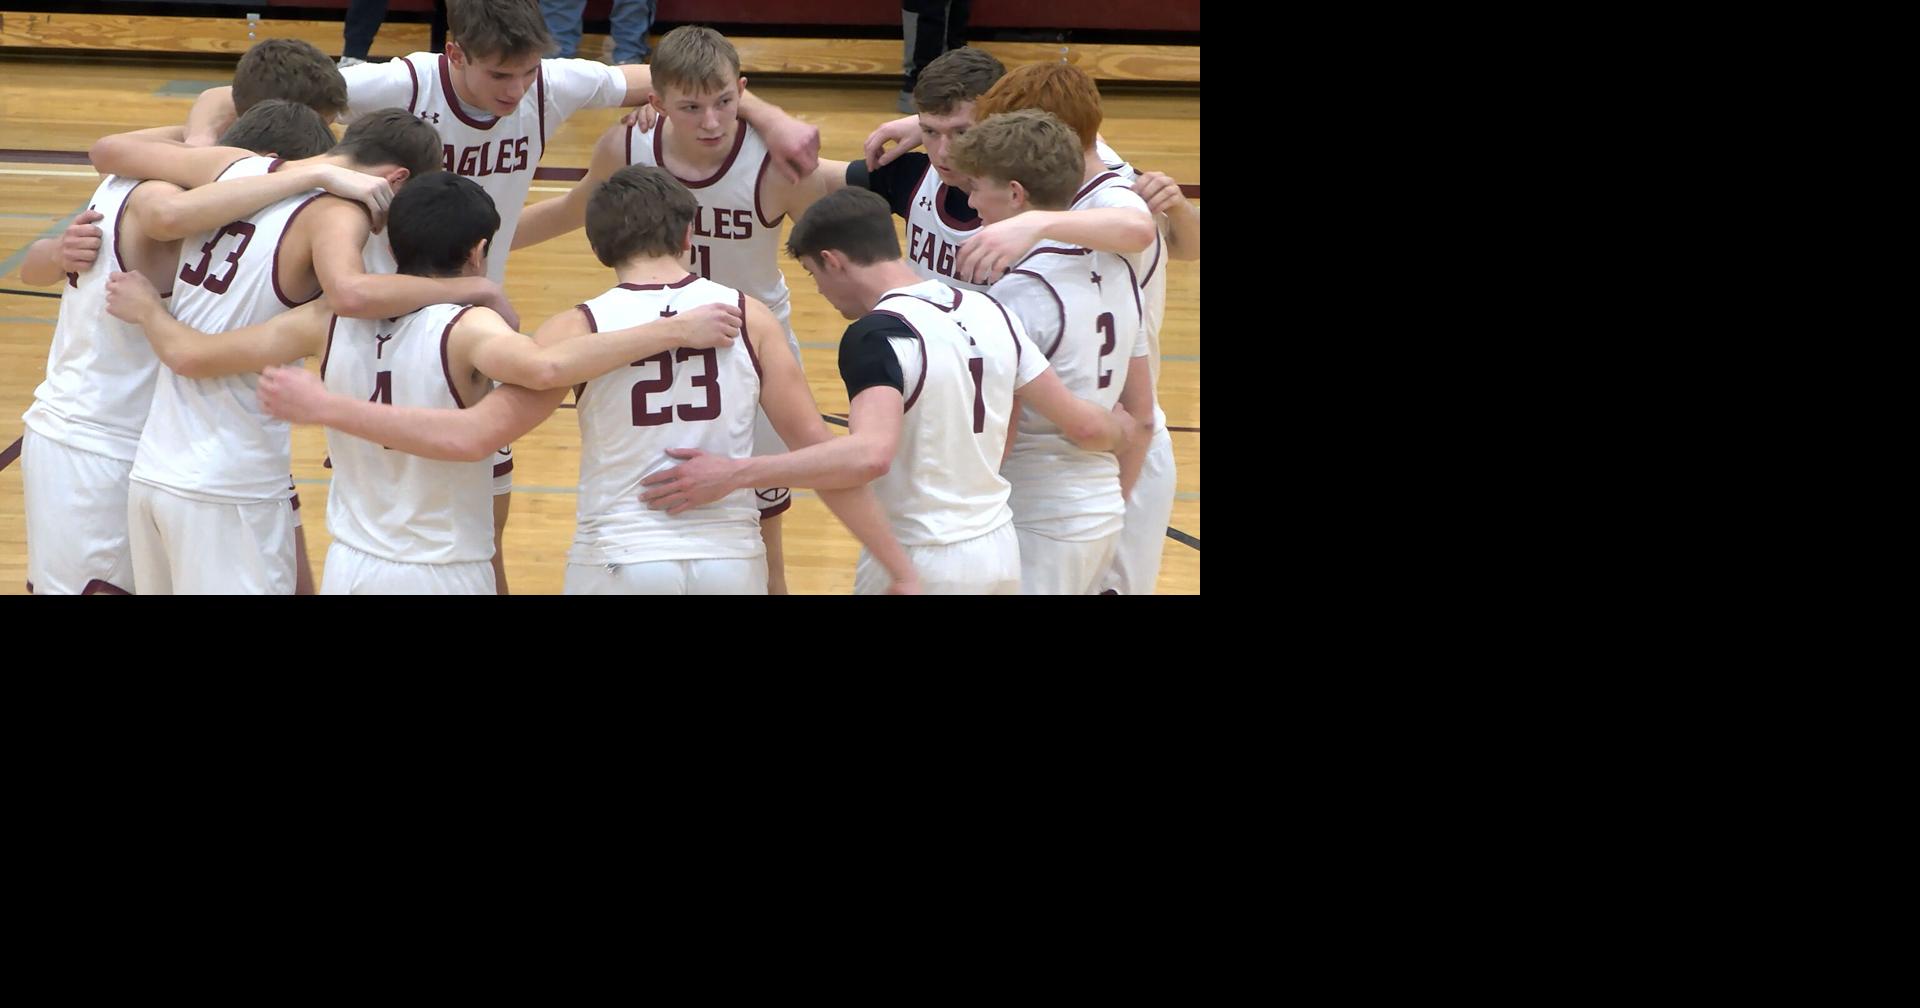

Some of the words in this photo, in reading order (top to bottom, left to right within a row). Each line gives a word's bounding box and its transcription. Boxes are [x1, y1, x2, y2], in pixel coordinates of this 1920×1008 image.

[443, 136, 529, 177] AGLES
[179, 221, 256, 295] 33
[693, 205, 753, 240] LES
[630, 346, 722, 426] 23
[1096, 311, 1115, 389] 2
[968, 357, 985, 434] 1
